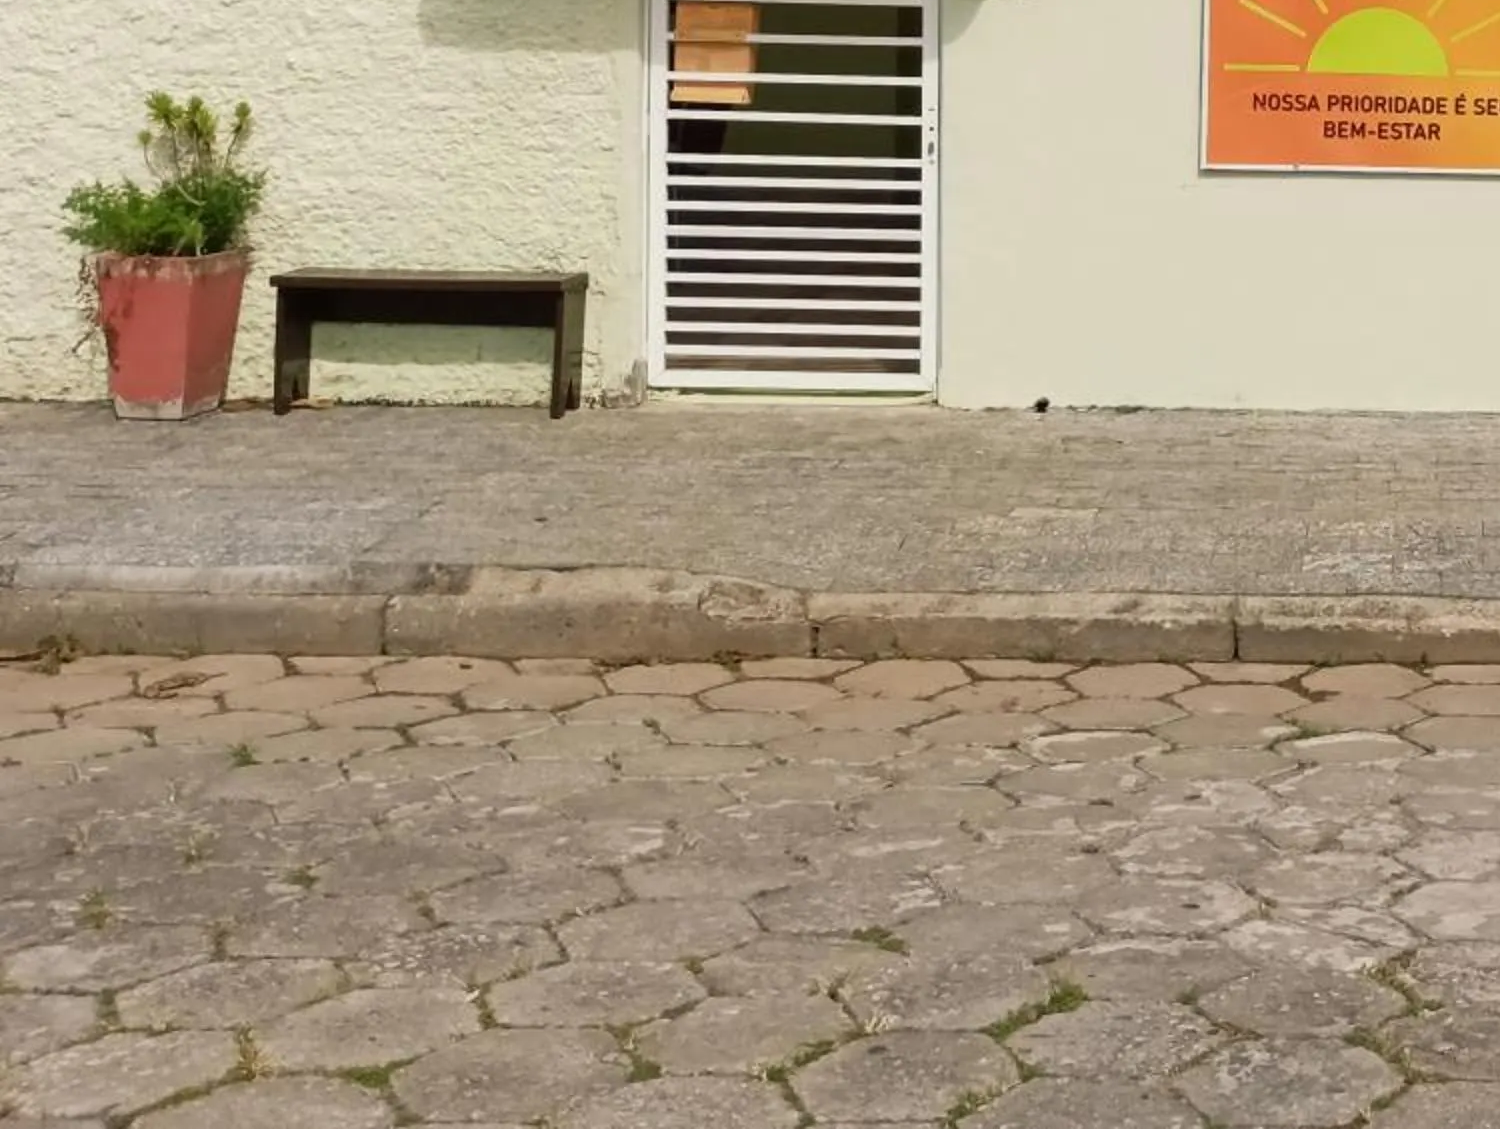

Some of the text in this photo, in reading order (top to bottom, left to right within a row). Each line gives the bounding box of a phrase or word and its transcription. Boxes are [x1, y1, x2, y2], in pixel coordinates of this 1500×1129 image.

[1252, 94, 1320, 112] NOSSA
[1327, 94, 1447, 114] PRIORIDADE
[1454, 93, 1466, 114] É
[1323, 121, 1441, 140] BEM-ESTAR
